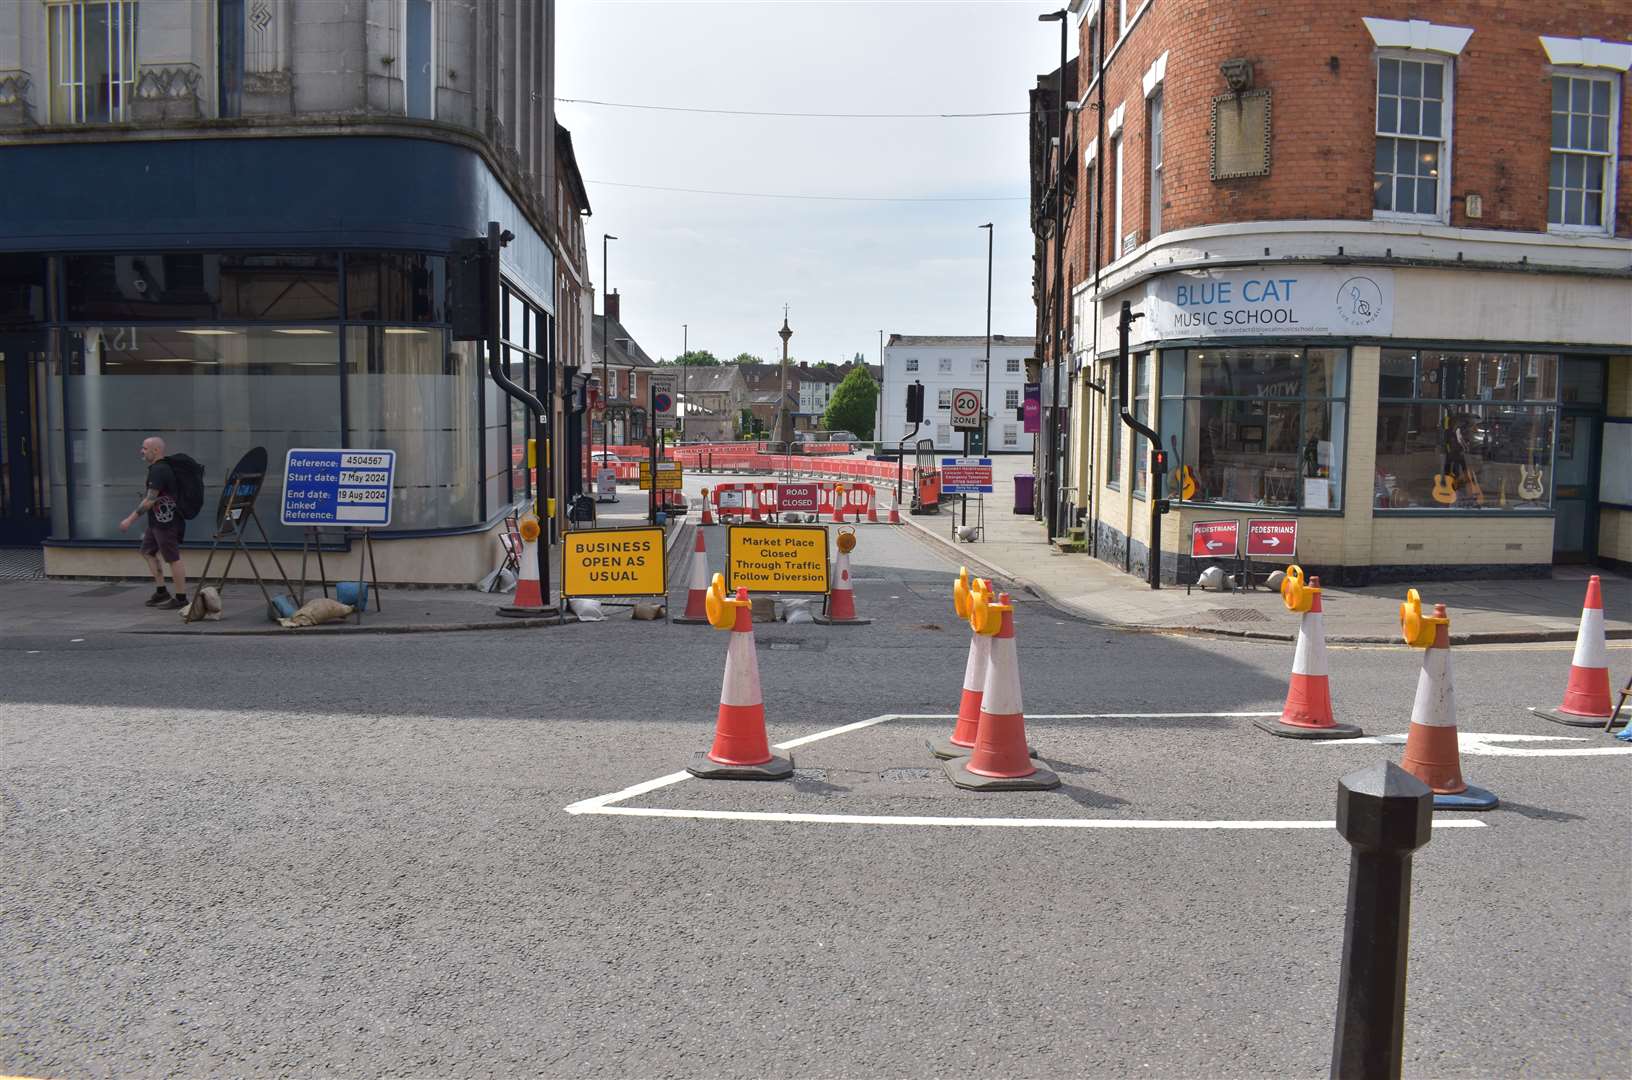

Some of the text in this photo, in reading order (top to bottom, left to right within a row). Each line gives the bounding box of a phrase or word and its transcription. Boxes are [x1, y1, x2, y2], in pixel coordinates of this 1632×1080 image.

[1176, 279, 1297, 306] BLUE CAT
[1174, 308, 1299, 327] MUSIC SCHOOL
[958, 398, 975, 409] 20
[953, 416, 977, 425] ZONE
[290, 456, 382, 467] Reference: 4504567
[288, 472, 386, 483] Start date: 7 May 2024
[287, 490, 386, 500] End date: 19 Aug 2024
[786, 488, 808, 496] ROAD
[286, 501, 317, 510] Linked
[782, 499, 813, 507] CLOSED
[285, 510, 335, 519] Reference:
[1194, 525, 1236, 533] PEDESTRIANS
[1250, 526, 1294, 534] PEDESTRIANS
[575, 541, 651, 553] BUSINESS
[742, 537, 815, 547] Market Place
[760, 549, 798, 558] Closed
[582, 556, 645, 567] OPEN AS
[736, 560, 821, 570] Through Traffic
[590, 571, 639, 582] USUAL
[733, 572, 824, 581] Follow Diversion
